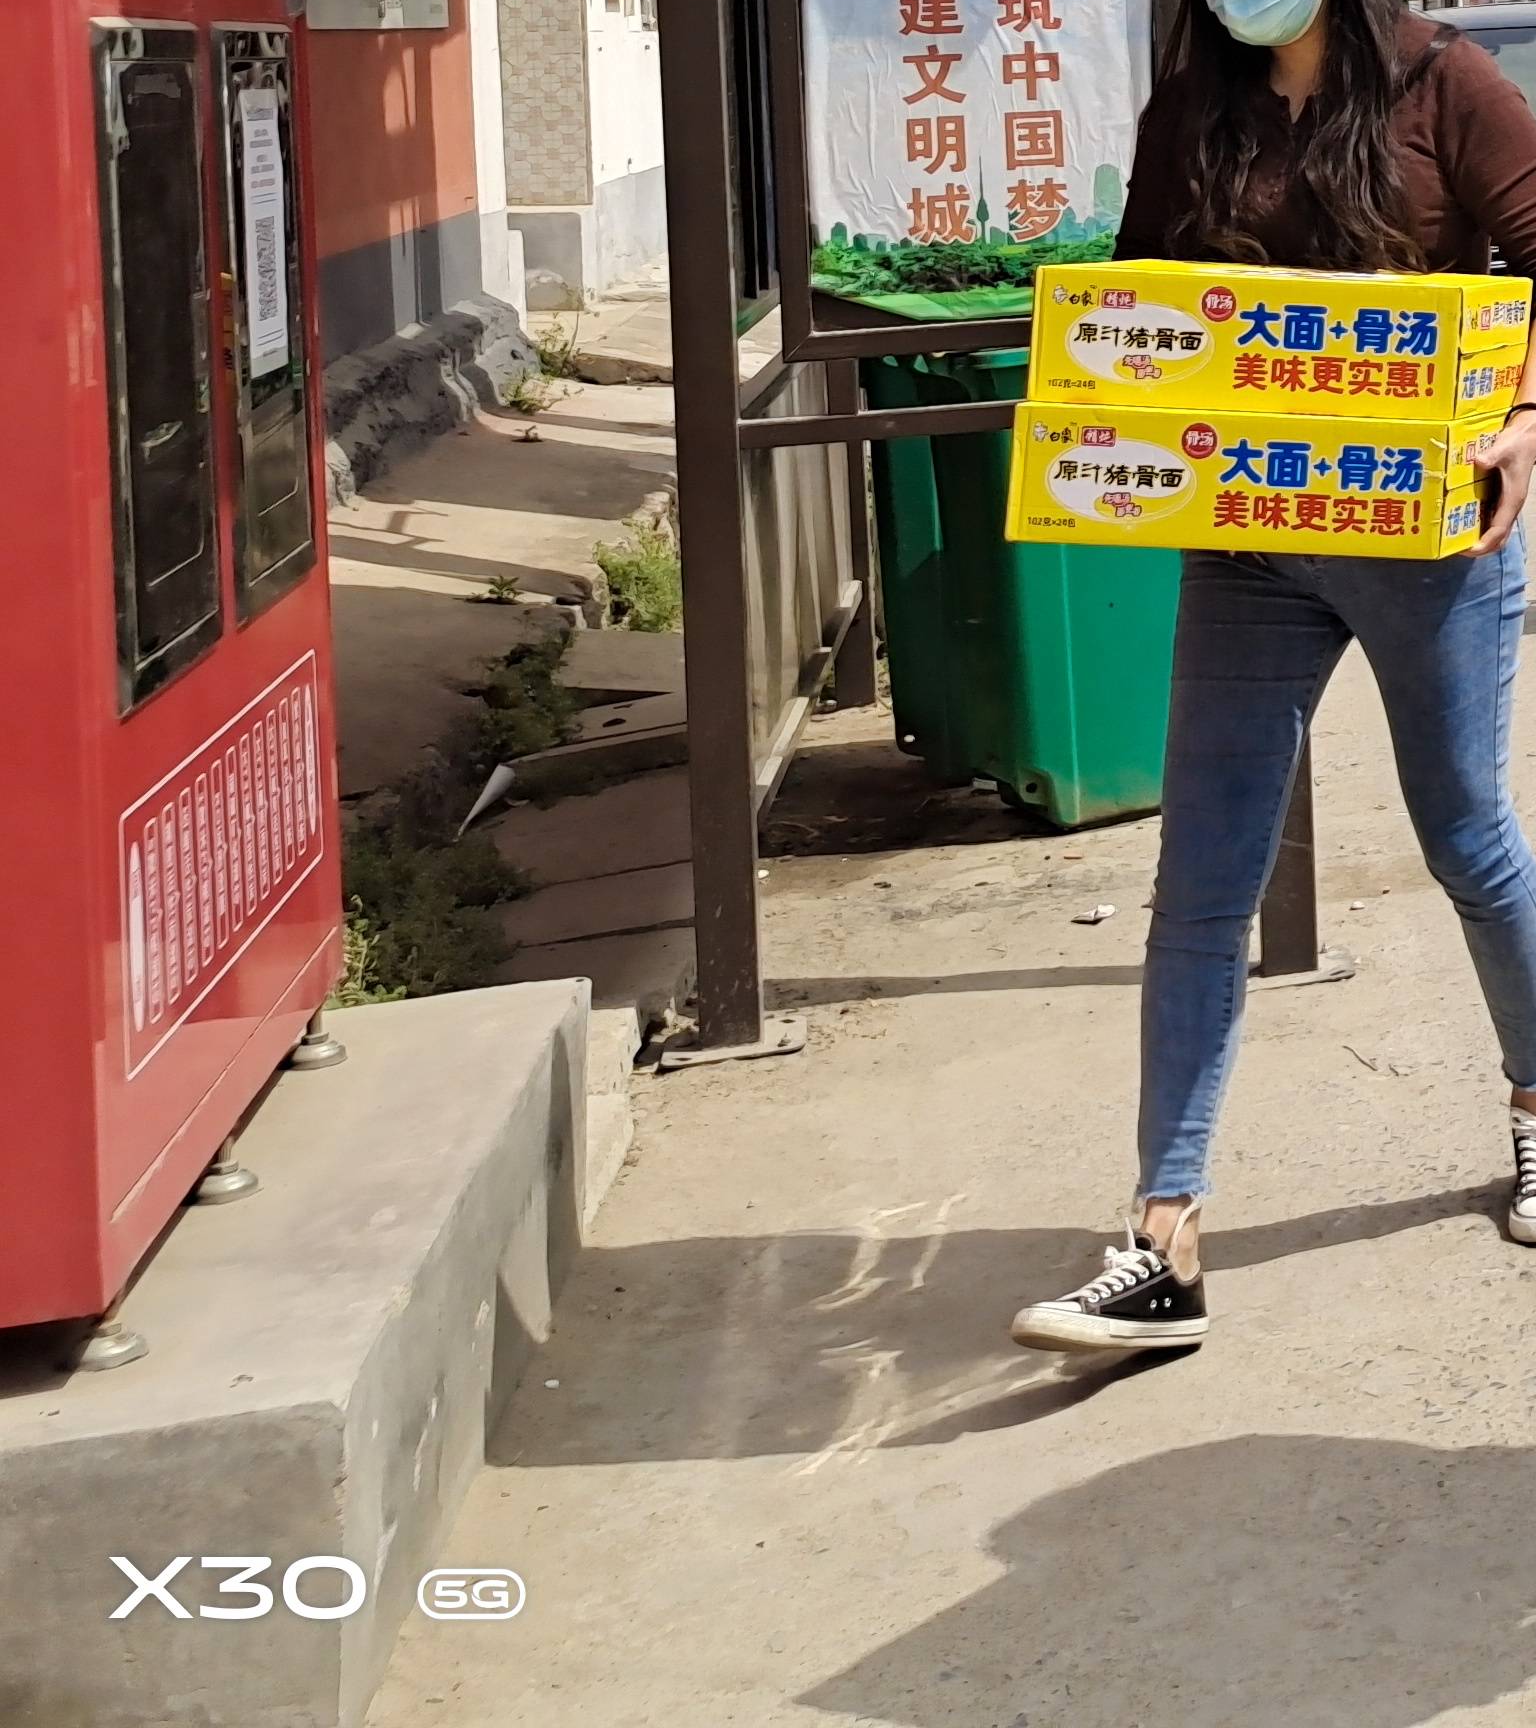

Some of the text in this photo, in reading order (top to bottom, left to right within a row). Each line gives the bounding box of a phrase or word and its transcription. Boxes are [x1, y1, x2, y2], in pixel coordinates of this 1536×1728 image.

[1073, 322, 1205, 352] 原汁猪骨面
[1237, 302, 1438, 356] 大面+骨汤
[1233, 353, 1436, 399] 美味更实惠!
[1053, 460, 1186, 489] 原汁猪骨面
[1219, 438, 1423, 493] 大面+骨汤
[1213, 489, 1422, 536] 美味更实惠!
